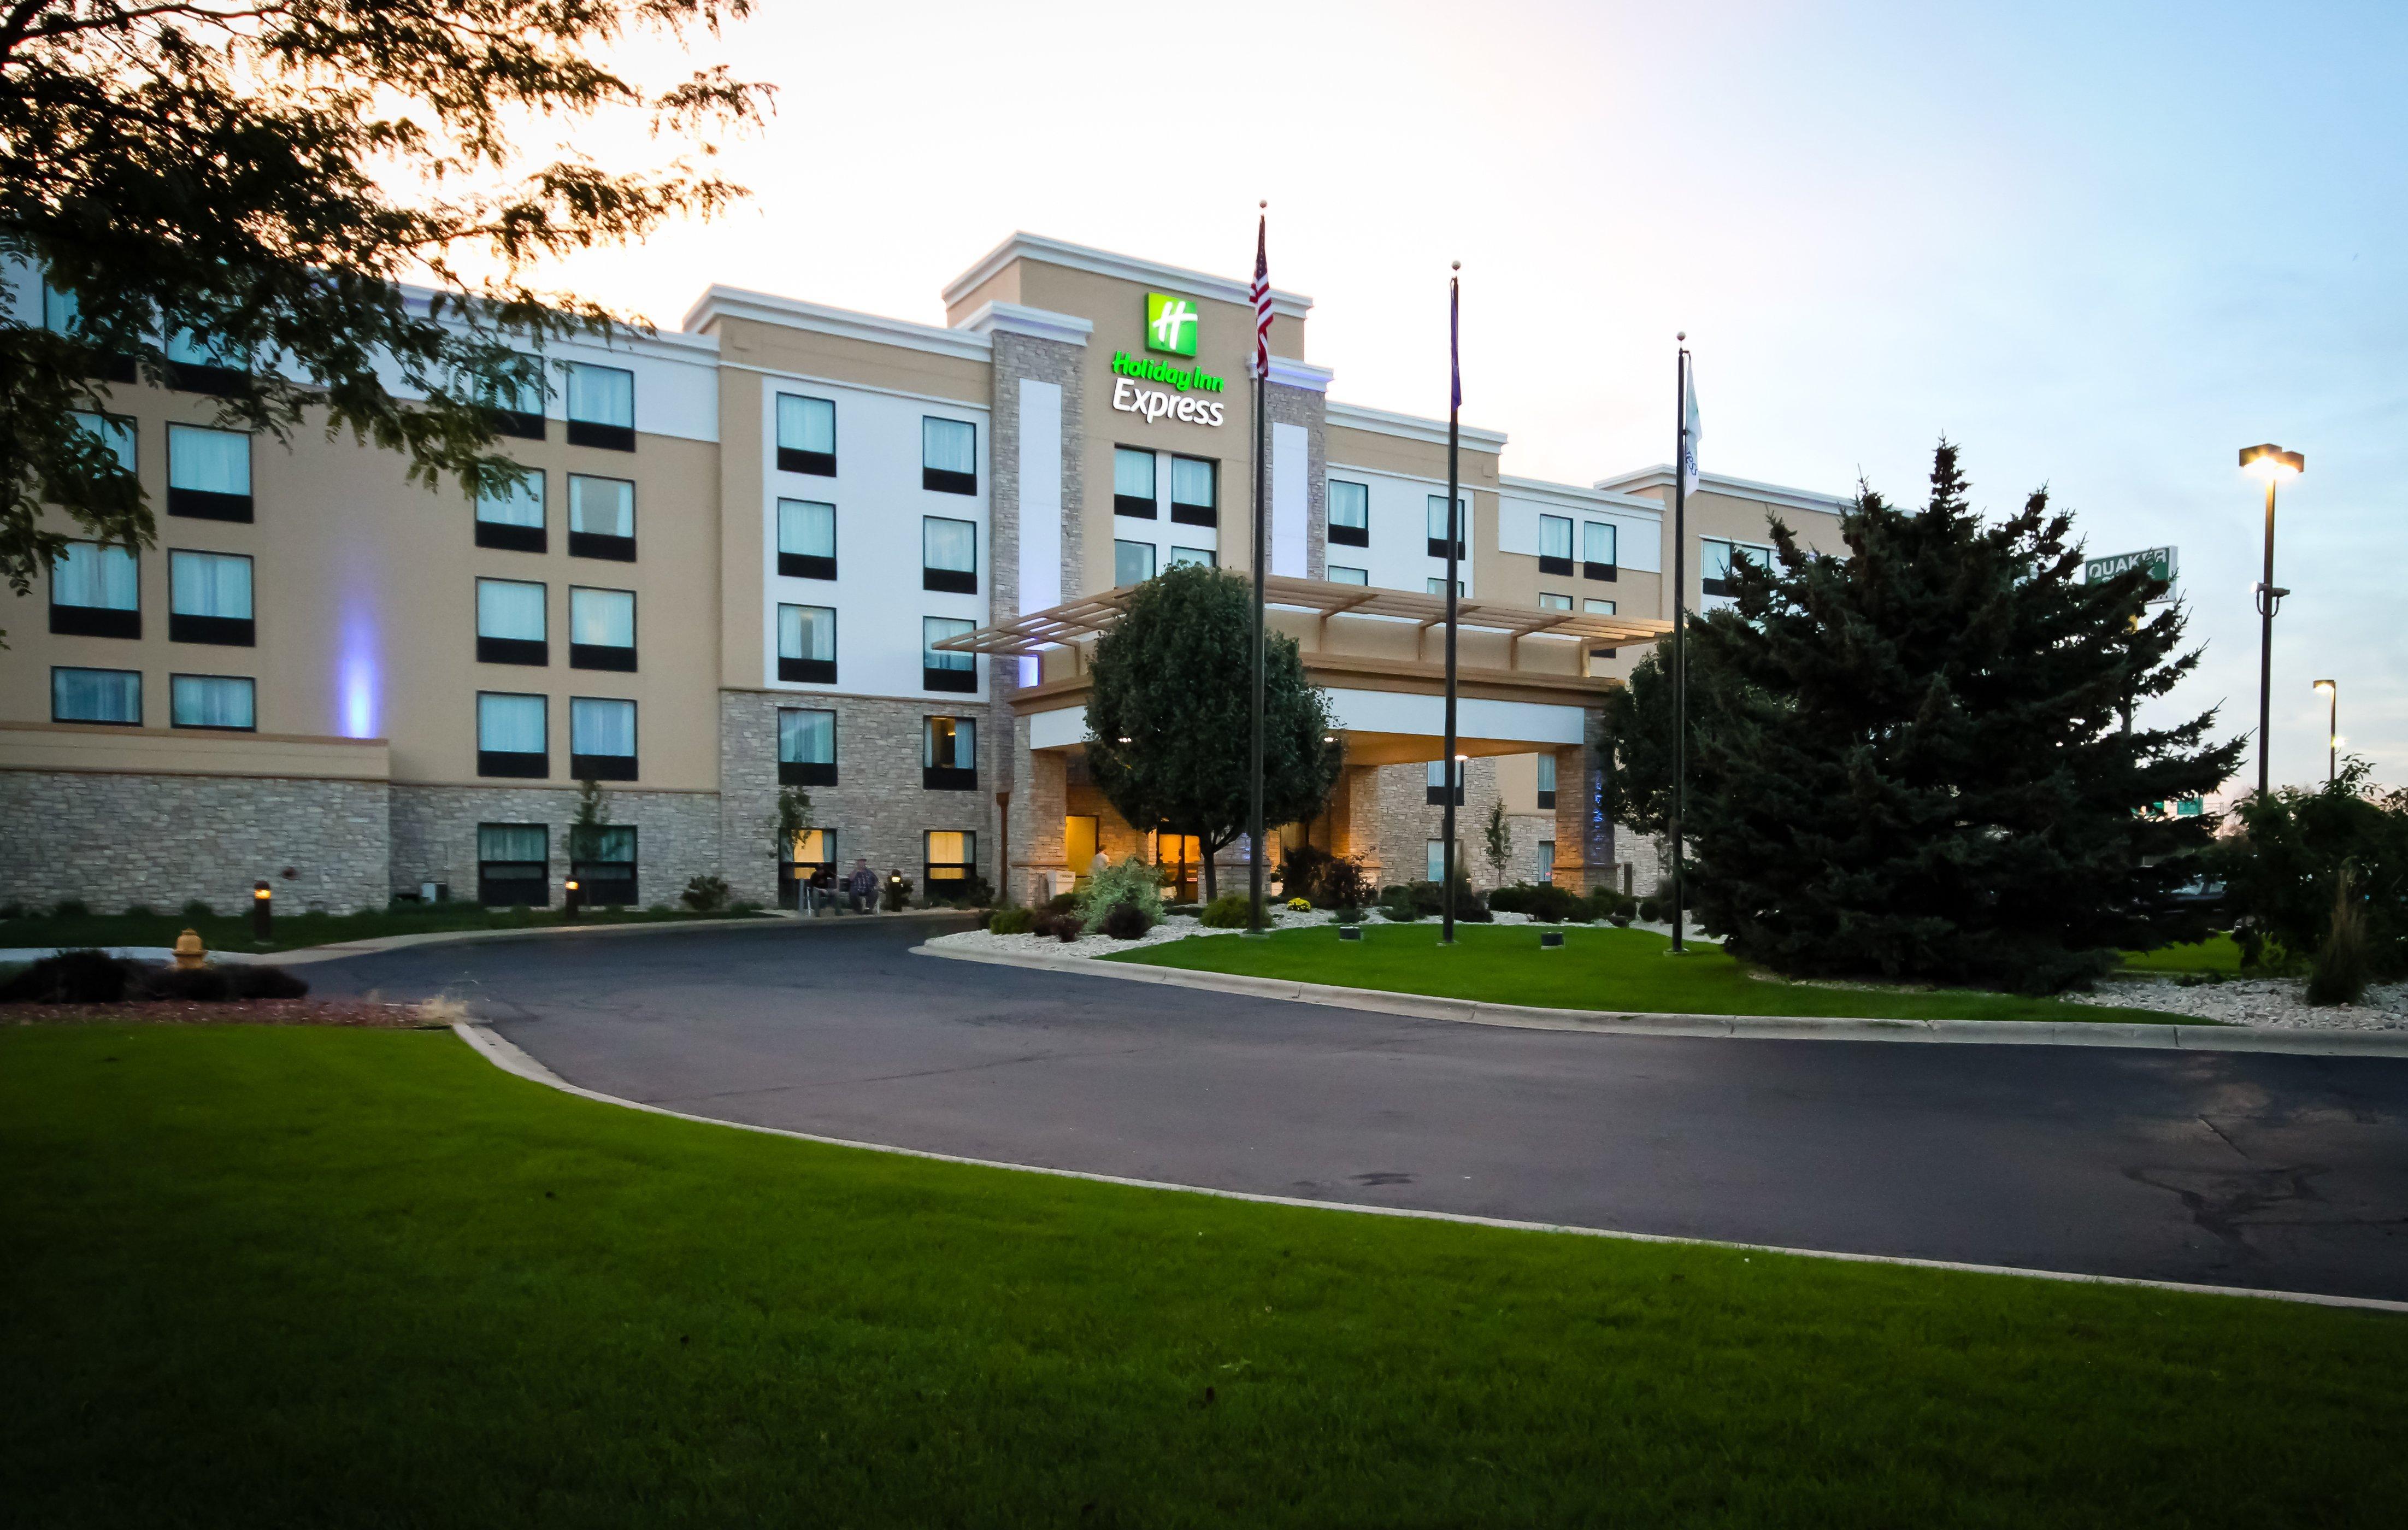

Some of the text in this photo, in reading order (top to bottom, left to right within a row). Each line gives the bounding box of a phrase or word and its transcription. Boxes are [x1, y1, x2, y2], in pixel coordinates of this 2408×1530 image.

[1112, 350, 1224, 392] Holiday Inn
[1112, 377, 1224, 427] Express
